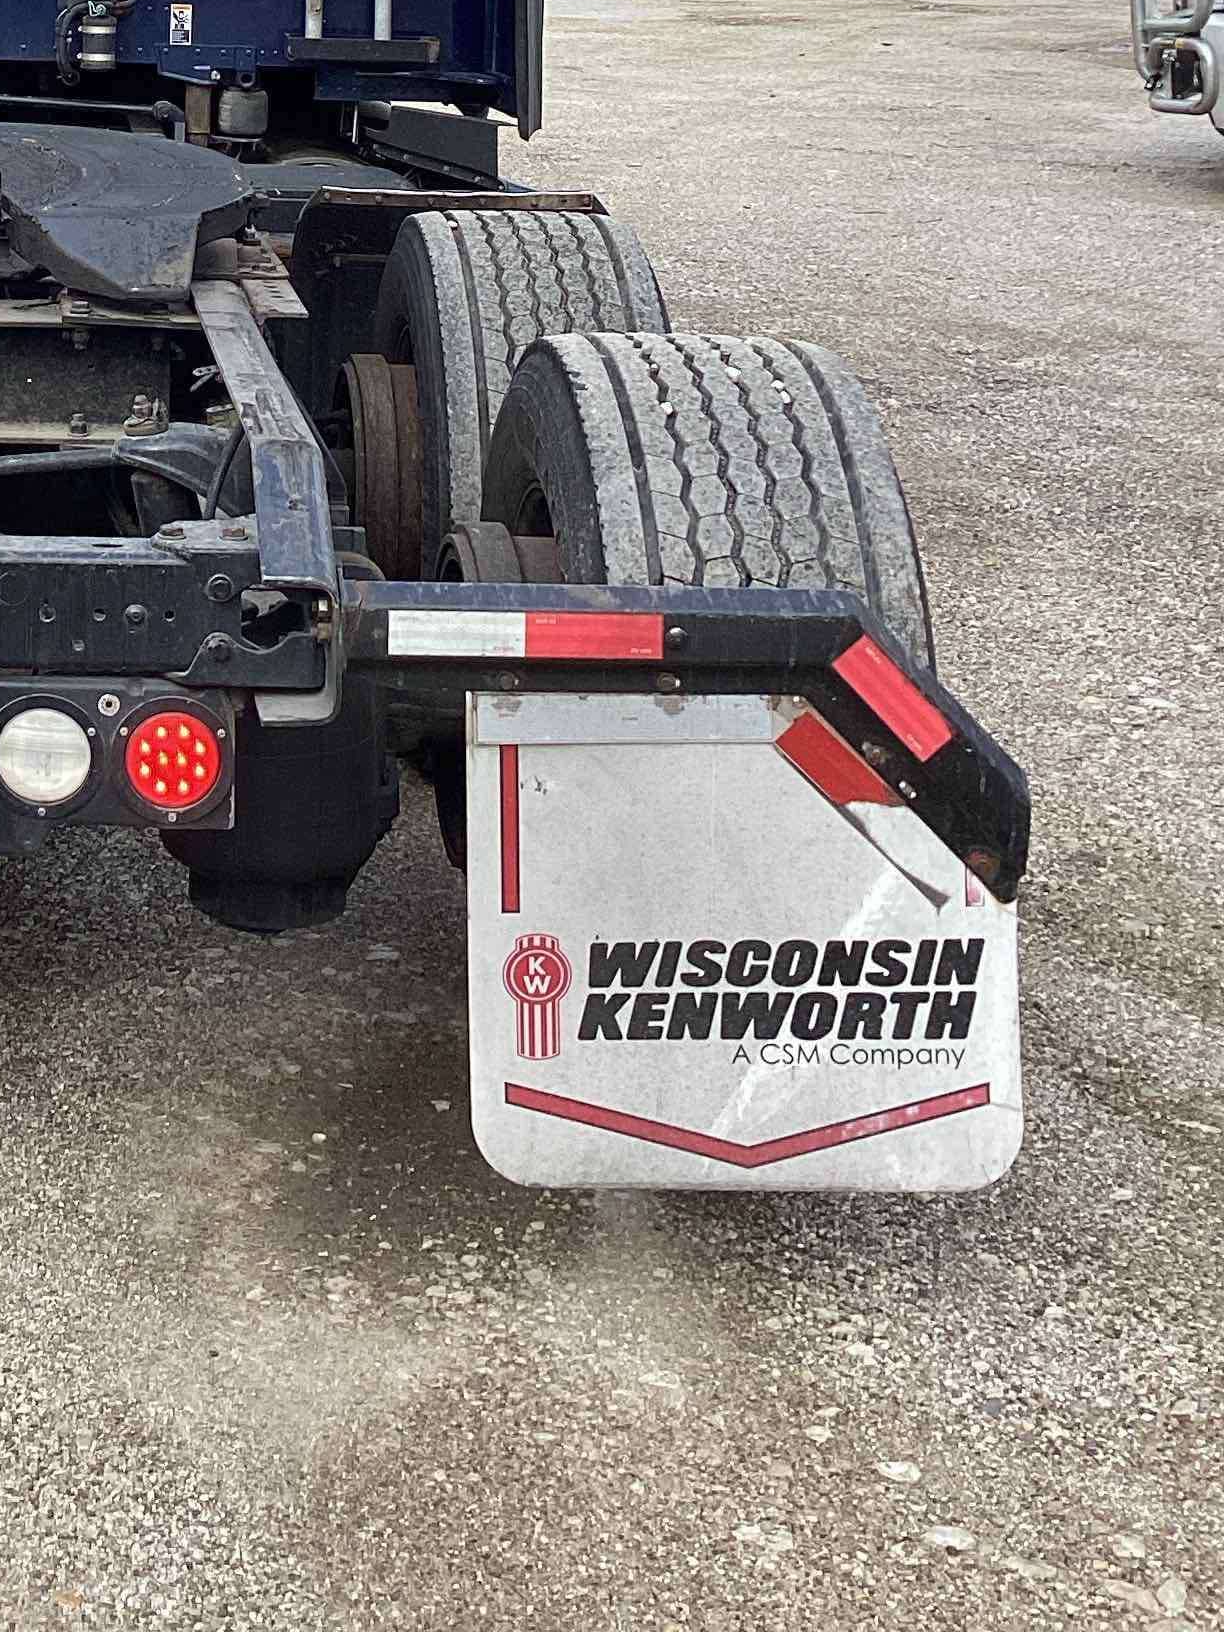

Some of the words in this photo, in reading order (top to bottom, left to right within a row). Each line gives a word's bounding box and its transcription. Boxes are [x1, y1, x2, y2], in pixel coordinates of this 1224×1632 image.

[529, 956, 546, 976] K
[588, 938, 984, 988] WISCONSIN
[524, 975, 551, 994] W
[577, 992, 978, 1041] KENWORTH
[732, 1046, 752, 1065] A
[760, 1045, 820, 1066] CSM
[828, 1044, 966, 1070] Company
